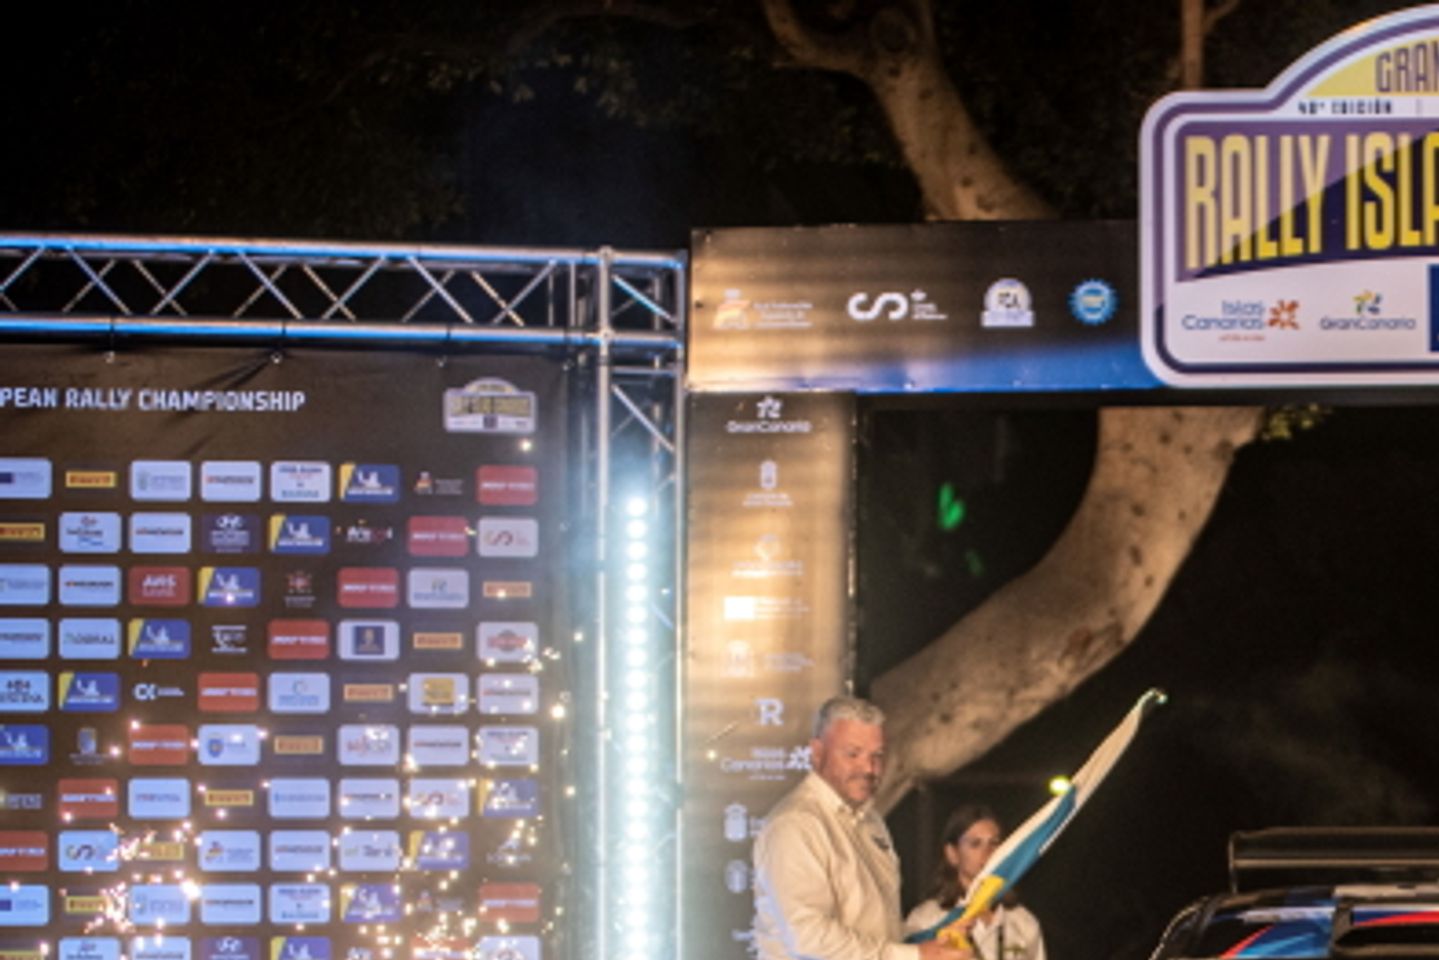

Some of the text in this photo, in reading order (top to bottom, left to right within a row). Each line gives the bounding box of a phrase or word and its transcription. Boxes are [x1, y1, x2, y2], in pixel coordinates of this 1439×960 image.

[1184, 135, 1330, 271] RALLY
[1182, 315, 1265, 330] Canarias
[65, 387, 132, 411] RALLY
[138, 389, 306, 411] CHAMPIONSHIP
